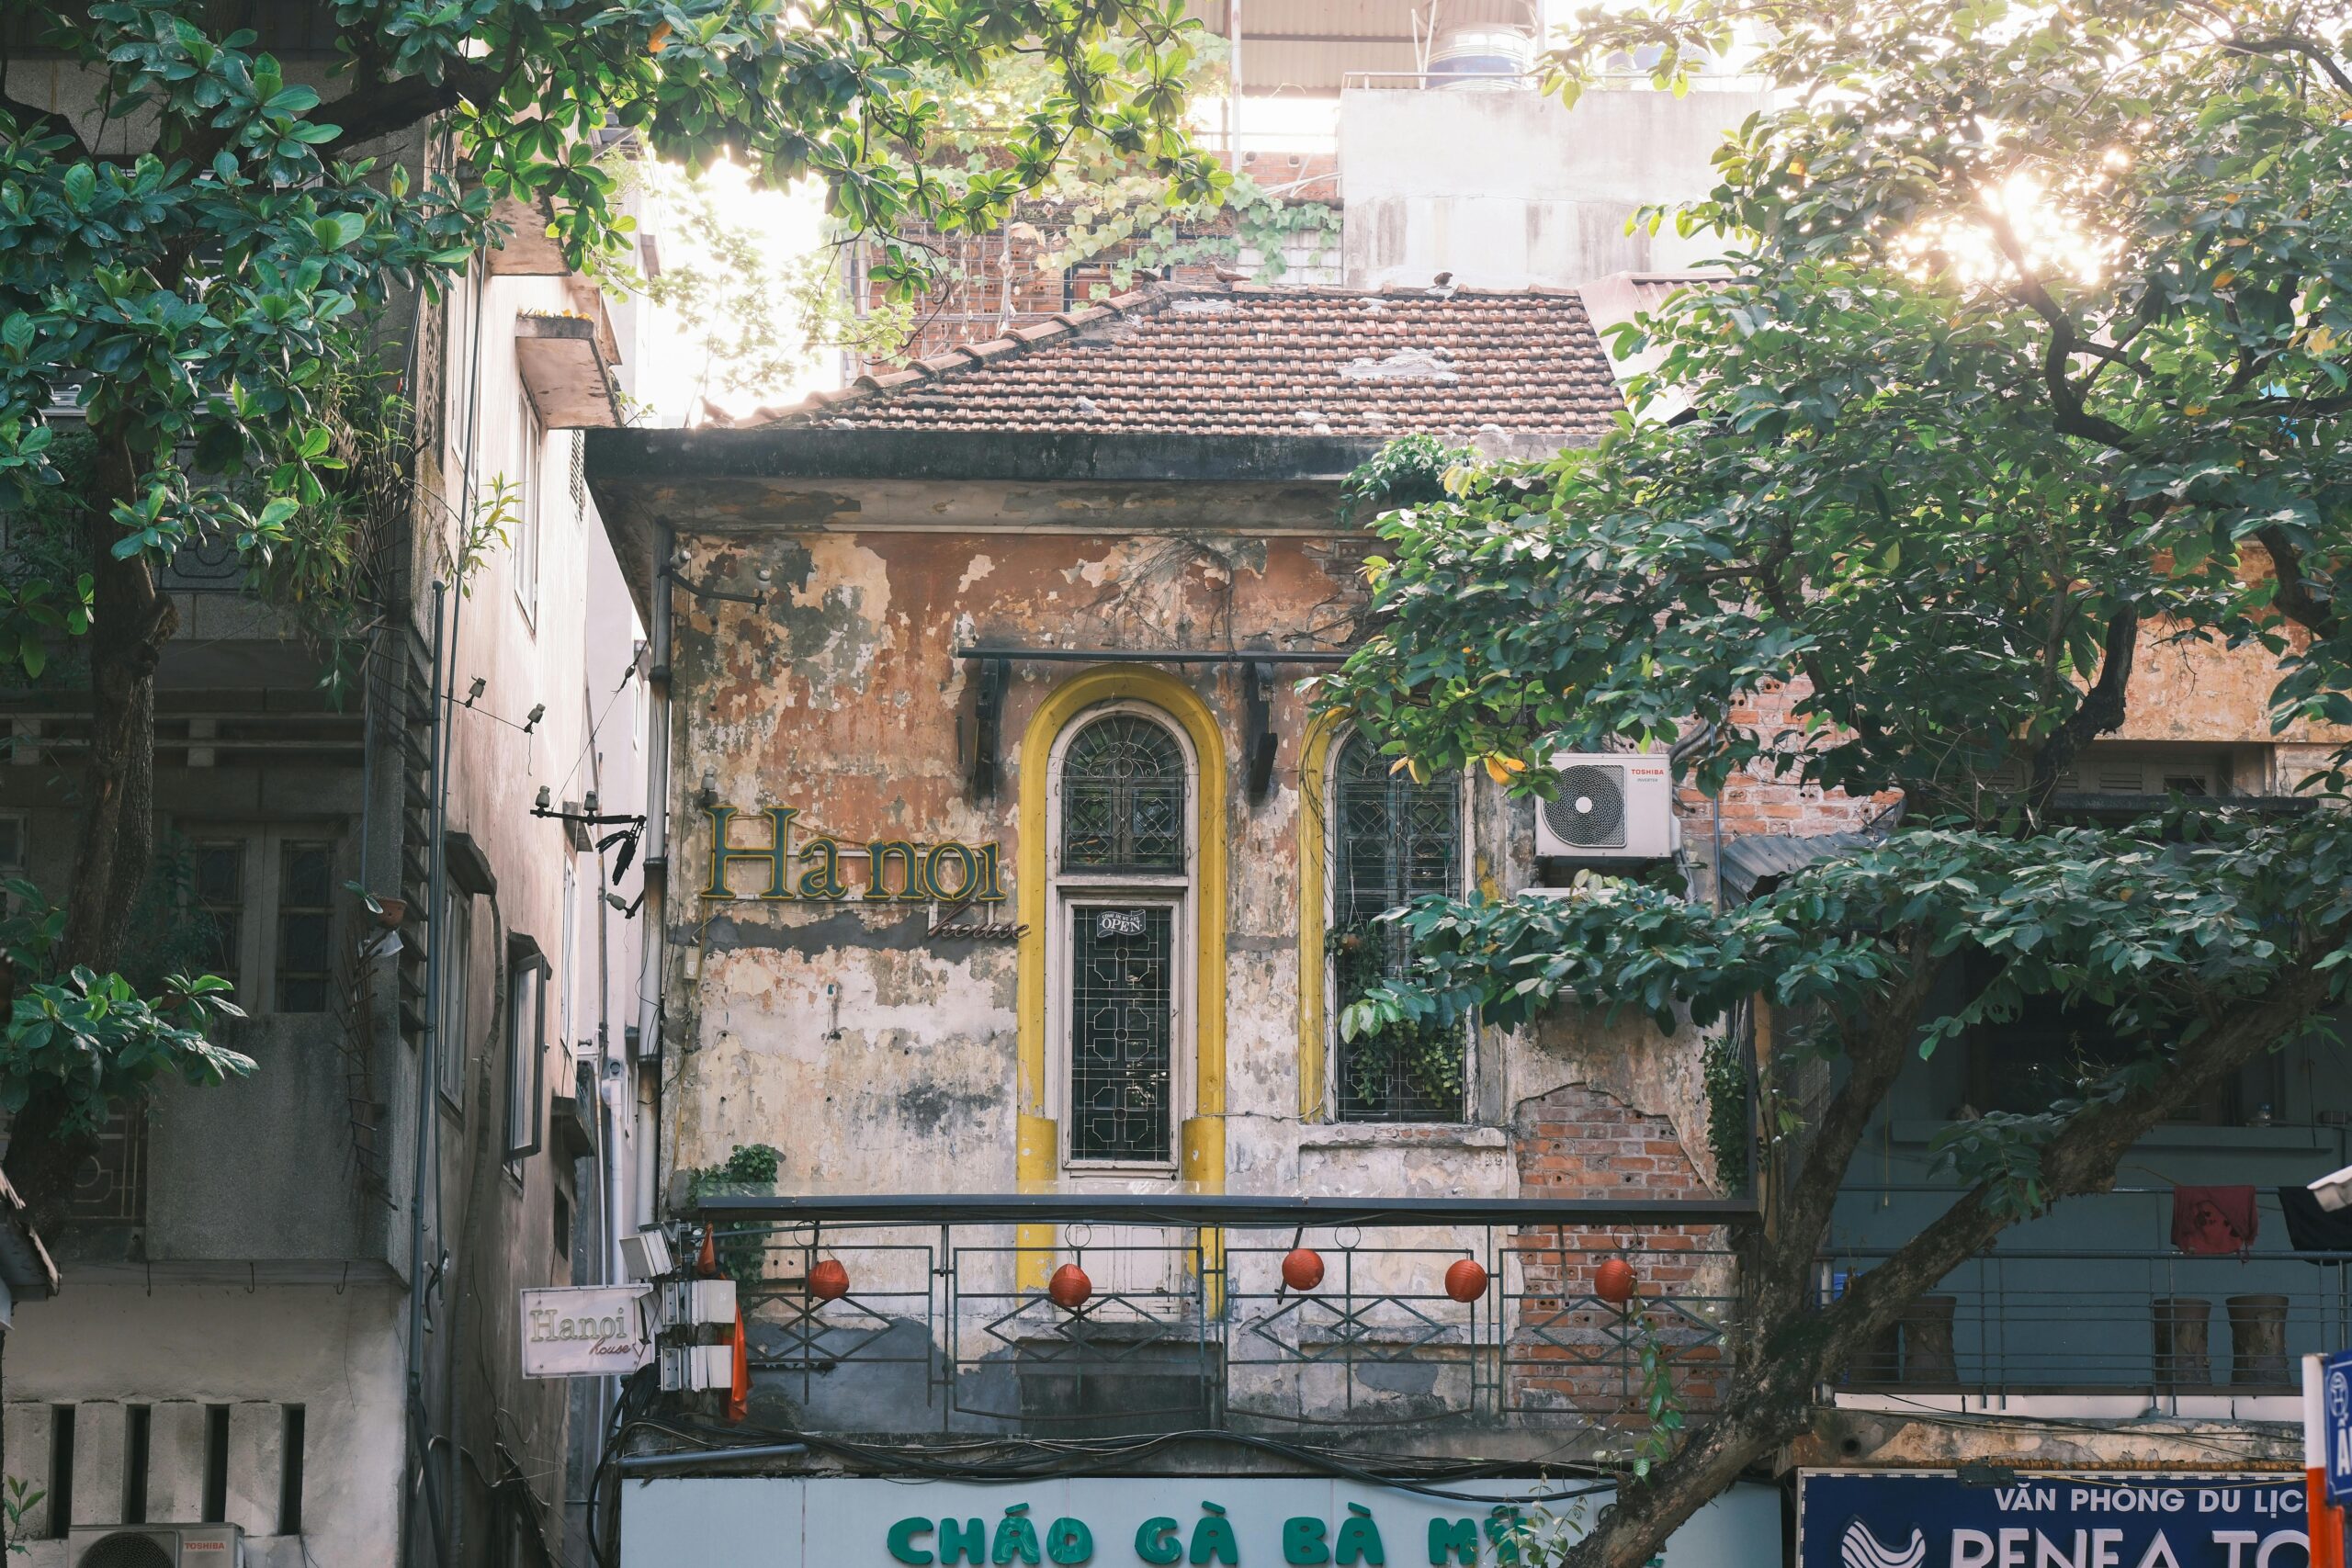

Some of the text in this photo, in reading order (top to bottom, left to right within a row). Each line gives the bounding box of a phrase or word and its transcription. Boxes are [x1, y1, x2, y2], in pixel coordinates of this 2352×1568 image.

[700, 805, 1007, 901] Hanoi
[926, 900, 1031, 942] house
[1102, 918, 1141, 932] OPEN
[529, 1307, 628, 1342] Hanoi
[589, 1337, 632, 1356] house
[1994, 1482, 2309, 1519] VĂN PHÒNG DU LỊC
[184, 1542, 225, 1551] TOSHIBA
[887, 1502, 1094, 1566] CHÁO
[1135, 1499, 1239, 1566] GÀ
[1283, 1500, 1391, 1566] BÀ
